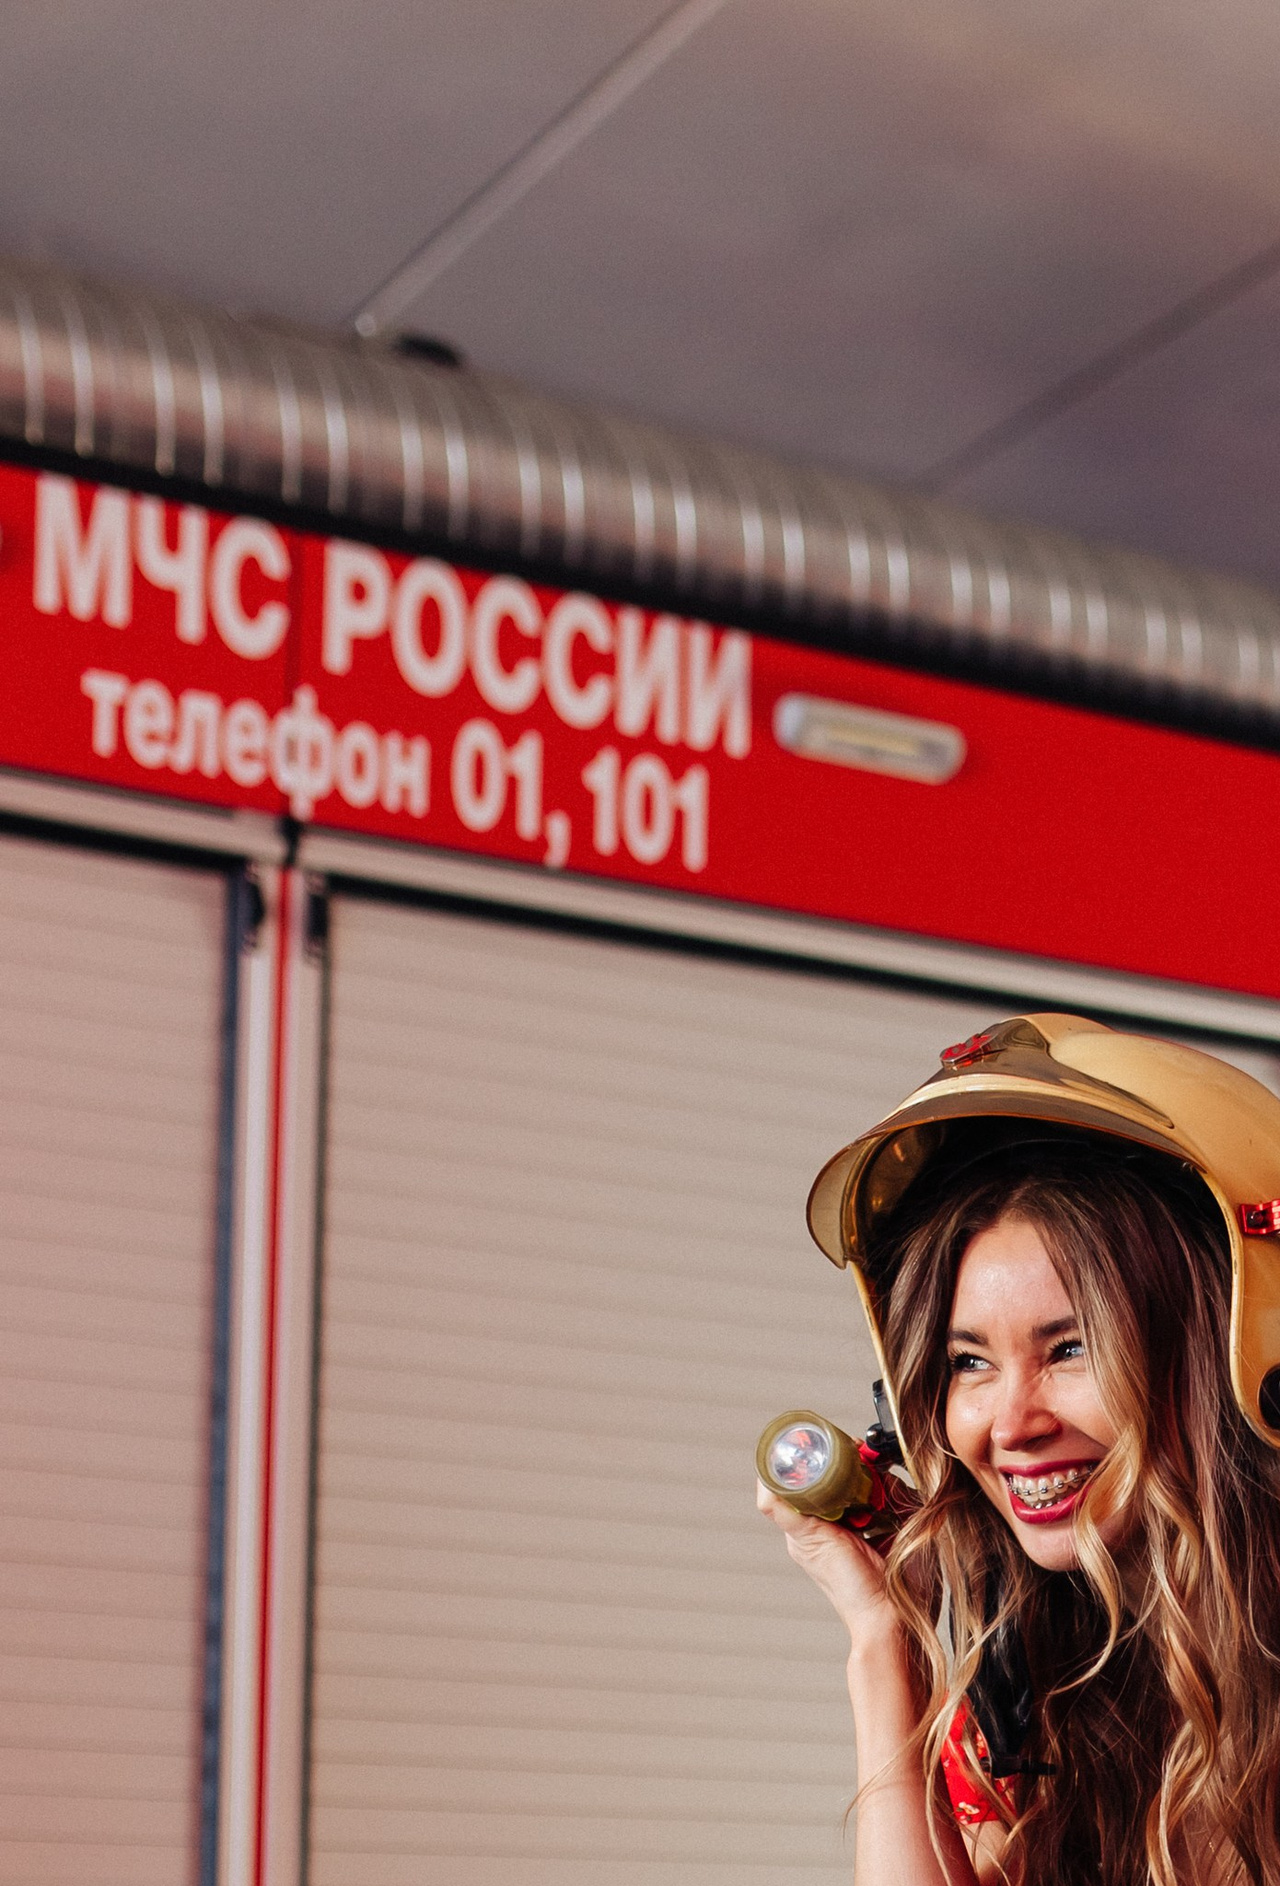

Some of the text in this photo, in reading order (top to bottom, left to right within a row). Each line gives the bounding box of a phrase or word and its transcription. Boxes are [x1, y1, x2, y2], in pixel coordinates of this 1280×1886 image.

[33, 473, 753, 758] МЧС РОССИИ
[80, 668, 431, 817] телефон
